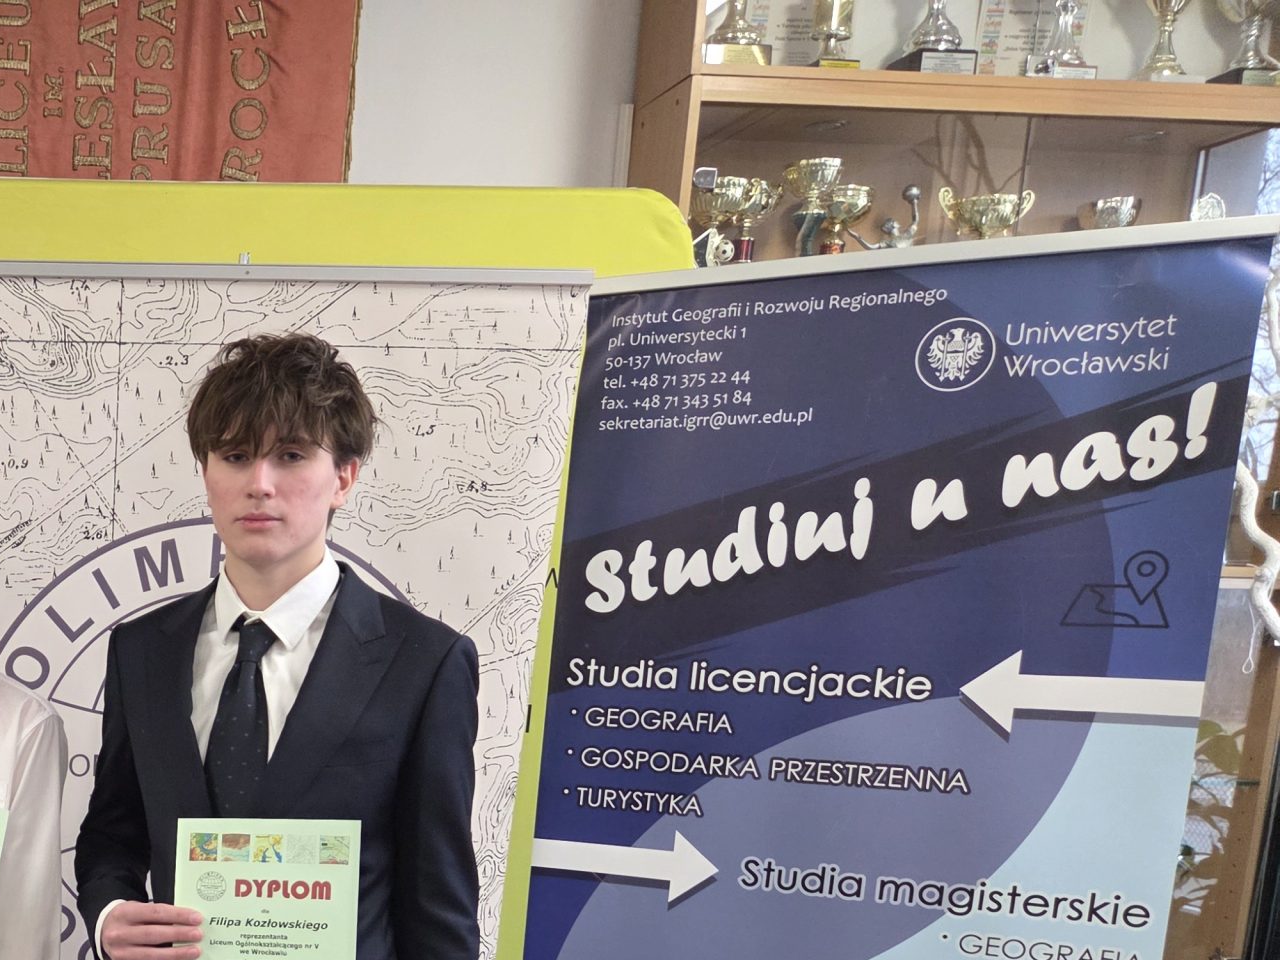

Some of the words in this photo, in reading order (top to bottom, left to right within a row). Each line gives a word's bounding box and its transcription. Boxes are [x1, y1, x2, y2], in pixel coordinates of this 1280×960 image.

[612, 310, 668, 328] Instytut
[672, 302, 741, 324] Geografii
[745, 303, 750, 317] i
[754, 297, 824, 316] Rozwoju
[829, 288, 948, 312] Regionalnego
[608, 336, 625, 351] pl.
[630, 326, 737, 346] Uniwersytecki
[740, 328, 746, 339] 1
[1005, 315, 1177, 346] Uniwersytet
[605, 355, 651, 371] 50-137
[655, 350, 723, 366] Wrocław
[1004, 347, 1171, 378] Wrocławski
[604, 375, 627, 389] tel.
[630, 374, 658, 389] +48
[662, 376, 677, 389] 71
[681, 372, 706, 387] 375
[711, 372, 727, 384] 22
[731, 370, 751, 386] 44
[601, 396, 628, 411] fax.
[632, 395, 660, 410] +48
[664, 397, 678, 410] 71
[682, 394, 708, 409] 343
[712, 393, 728, 407] 51
[732, 391, 752, 406] 84
[599, 408, 813, 432] sekretariat.igrr@uwr.edu.pl
[585, 477, 873, 613] Studiuj
[911, 478, 968, 530] u
[1002, 382, 1217, 507] nas!
[567, 657, 677, 689] Studia
[690, 660, 932, 702] licencjackie
[584, 706, 733, 734] GEOGRAFIA
[580, 747, 760, 779] GOSPODARKA
[770, 758, 969, 794] PRZESTRZENNA
[576, 787, 702, 816] TURYSTYKA
[235, 878, 331, 900] DYPLOM
[741, 859, 862, 898] Studia
[878, 877, 1151, 928] magisterskie
[209, 917, 241, 928] Filipa
[245, 918, 328, 932] Kozłowskiego
